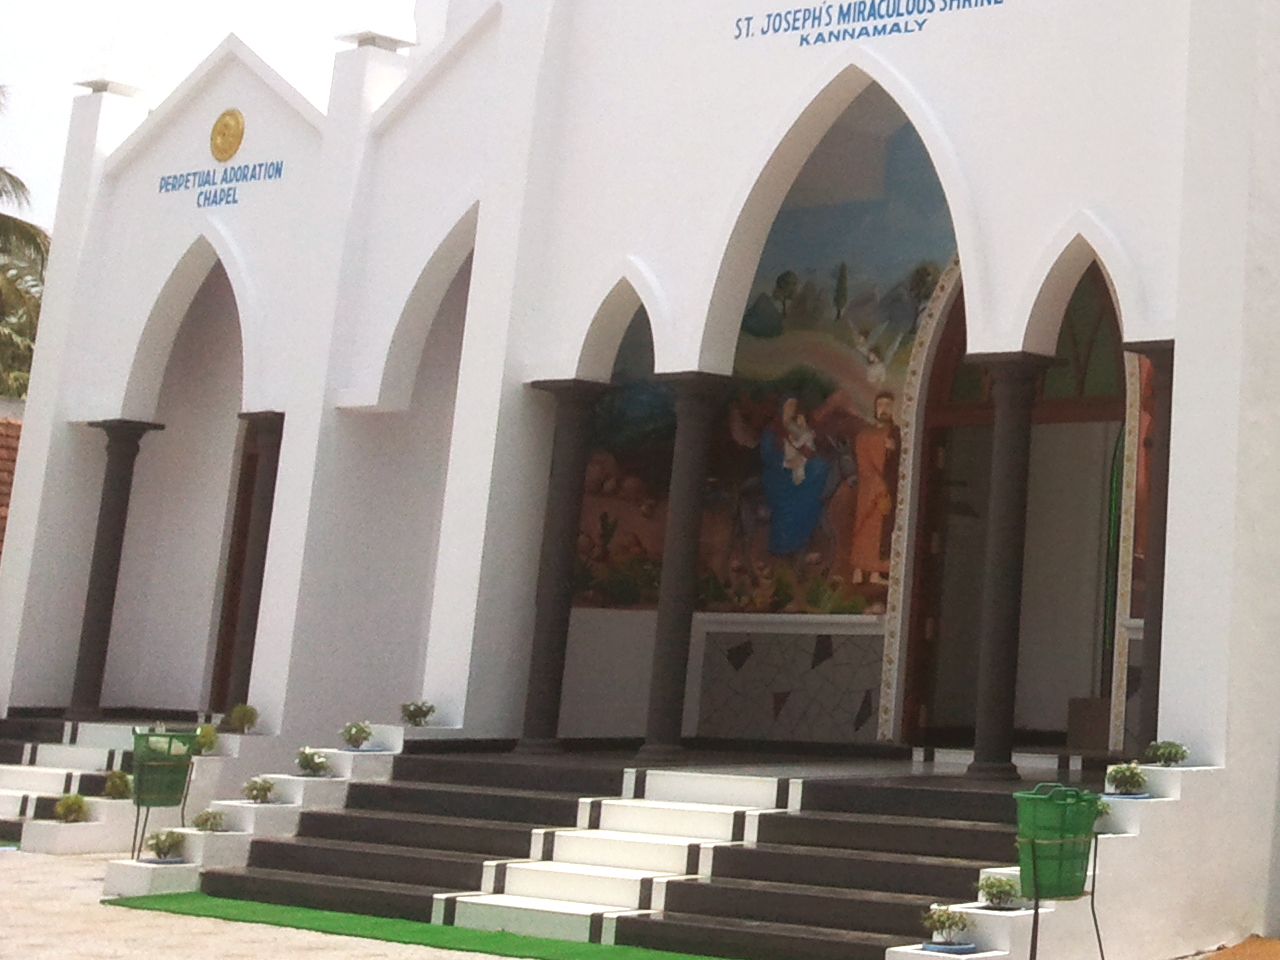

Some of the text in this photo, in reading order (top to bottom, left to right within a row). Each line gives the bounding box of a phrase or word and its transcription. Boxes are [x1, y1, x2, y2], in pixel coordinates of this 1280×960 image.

[734, 16, 755, 40] ST.
[761, 0, 833, 35] JOSEPH'S
[799, 18, 928, 47] KANNAMALY
[159, 161, 283, 193] PERPETUAL ADORATION
[196, 186, 238, 208] CHAPEL
